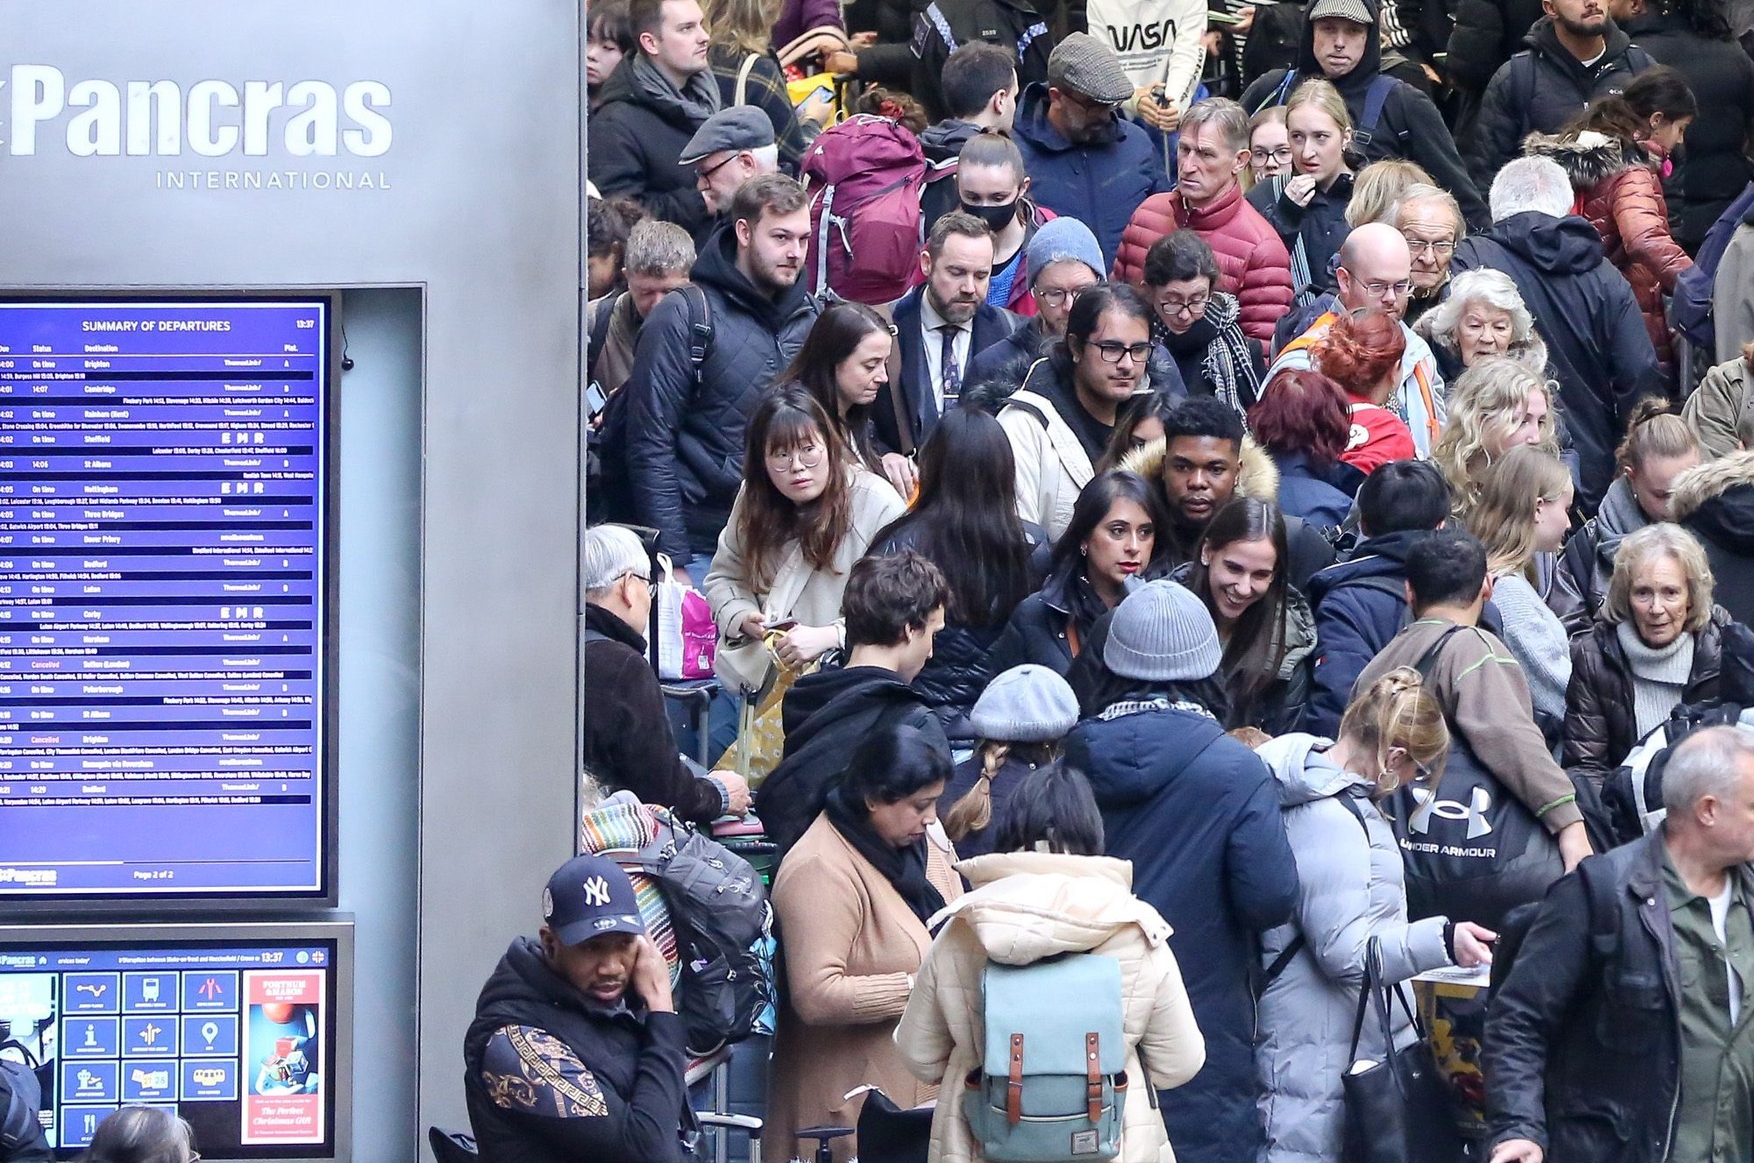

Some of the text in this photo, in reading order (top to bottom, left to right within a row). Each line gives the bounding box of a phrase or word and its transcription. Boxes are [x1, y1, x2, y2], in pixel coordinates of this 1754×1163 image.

[1107, 19, 1177, 52] NASA
[10, 64, 392, 157] Pancras
[157, 171, 391, 189] INTERNATIONAL
[82, 321, 138, 332] SUMMARY
[141, 321, 156, 332] OF
[158, 320, 231, 332] DEPARTURES
[32, 345, 52, 353] Status
[84, 344, 118, 353] Destination
[32, 360, 41, 368] On
[42, 360, 56, 368] time
[84, 360, 110, 369] Brighton
[84, 385, 116, 394] Cambridge
[32, 410, 41, 418] On
[42, 410, 56, 418] time
[32, 435, 41, 443] On
[42, 435, 56, 443] time
[84, 435, 110, 443] Sheffield
[32, 485, 41, 493] On
[42, 485, 56, 493] time
[84, 485, 118, 494] Nottingham
[32, 510, 41, 518] On
[42, 510, 56, 518] time
[84, 510, 101, 518] Three
[101, 510, 124, 519] Bridges
[32, 536, 41, 544] On
[42, 536, 56, 544] time
[32, 560, 41, 568] On
[42, 560, 56, 568] time
[83, 610, 101, 620] Corby
[31, 660, 60, 668] Cancelled
[31, 736, 60, 744] Cancelled
[1399, 837, 1496, 858] UNDER ARMOUR
[133, 871, 152, 881] Page
[152, 871, 159, 879] 2
[158, 870, 168, 879] of
[167, 870, 174, 879] 2
[261, 952, 283, 963] 13:37
